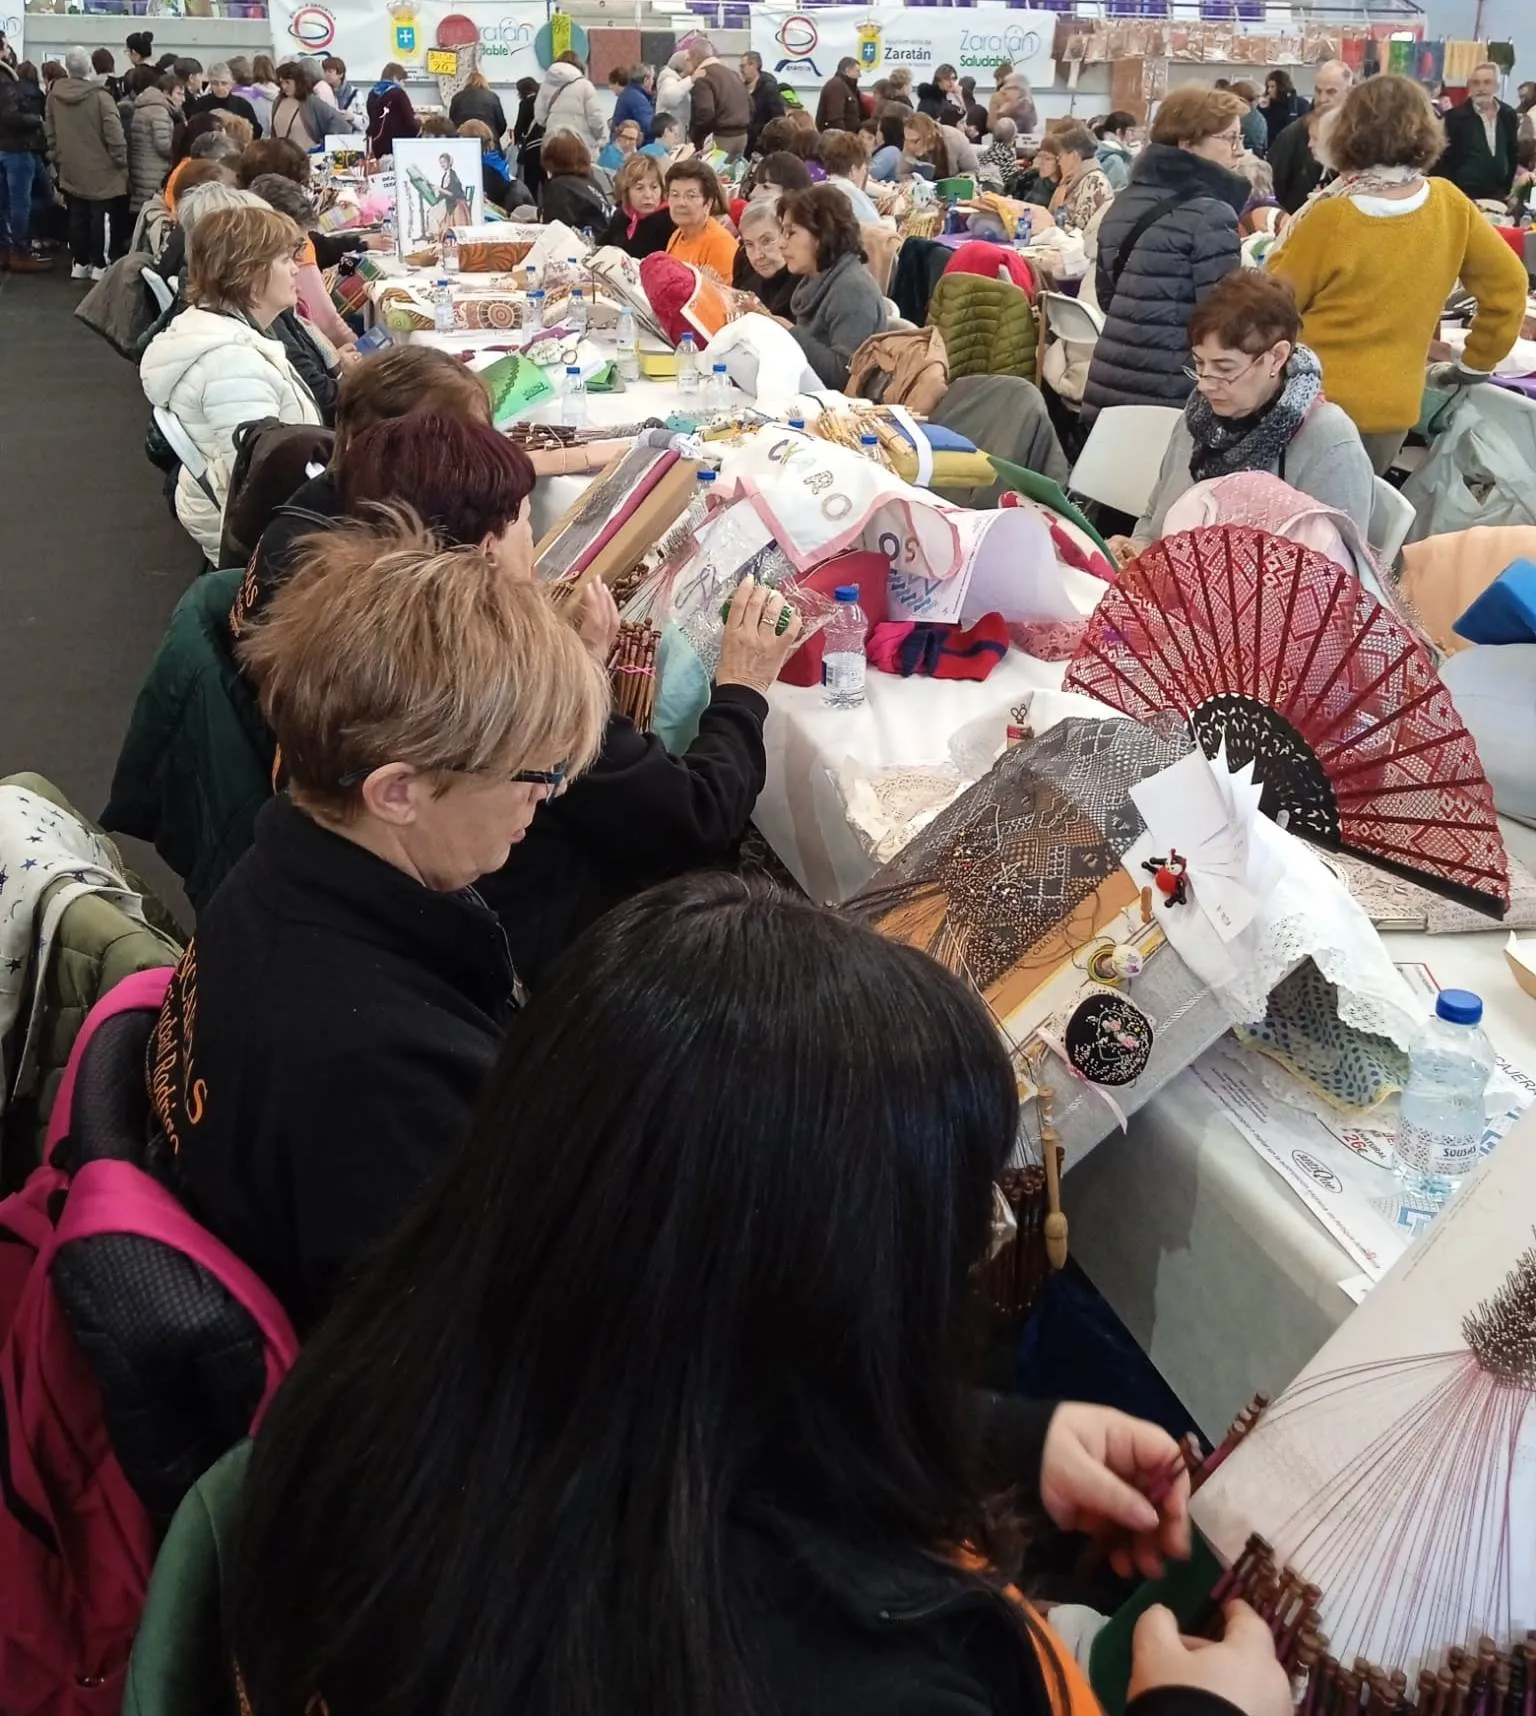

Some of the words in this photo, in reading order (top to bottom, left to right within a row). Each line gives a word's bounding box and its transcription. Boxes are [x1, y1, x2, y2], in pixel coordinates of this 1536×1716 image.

[960, 29, 1034, 51] Zaratán
[884, 47, 931, 60] Zaratán
[960, 54, 1012, 67] Saludable
